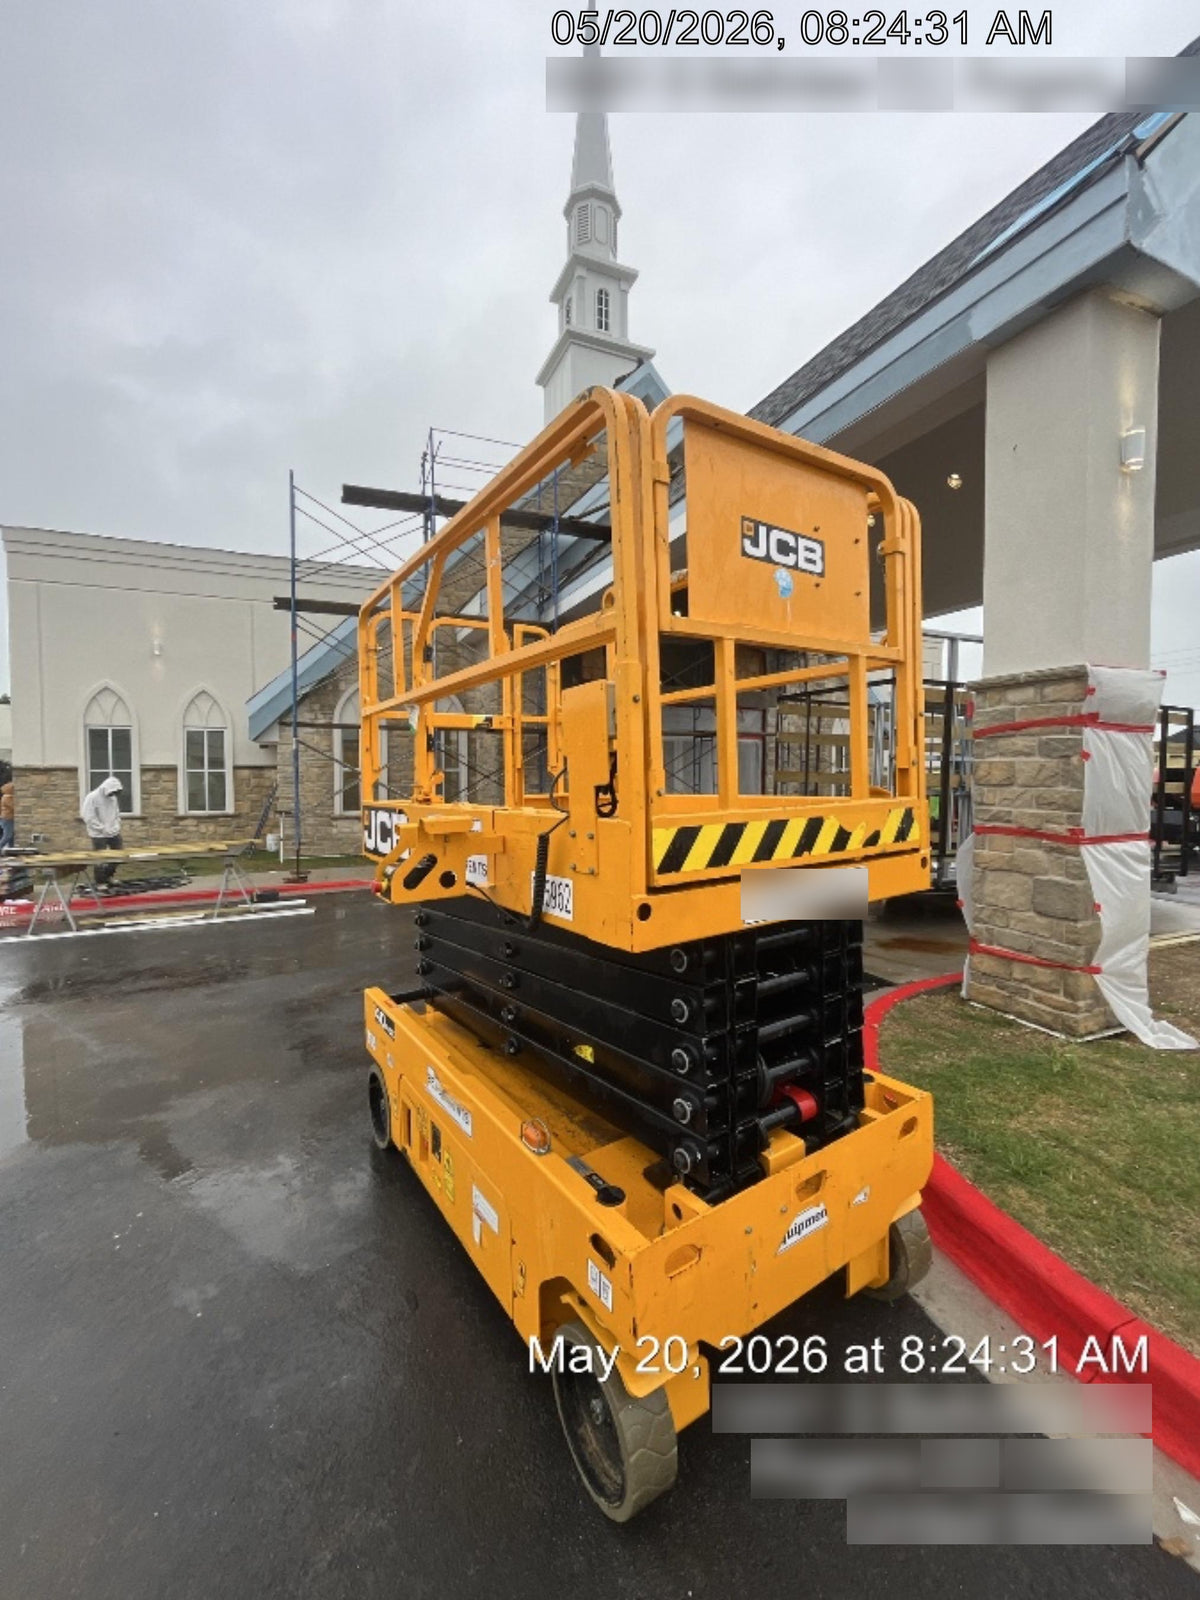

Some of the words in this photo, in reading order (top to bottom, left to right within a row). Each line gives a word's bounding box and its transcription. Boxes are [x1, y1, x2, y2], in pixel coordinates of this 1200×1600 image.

[743, 526, 823, 573] JCB
[466, 860, 488, 877] ENTS
[534, 876, 571, 914] 5962
